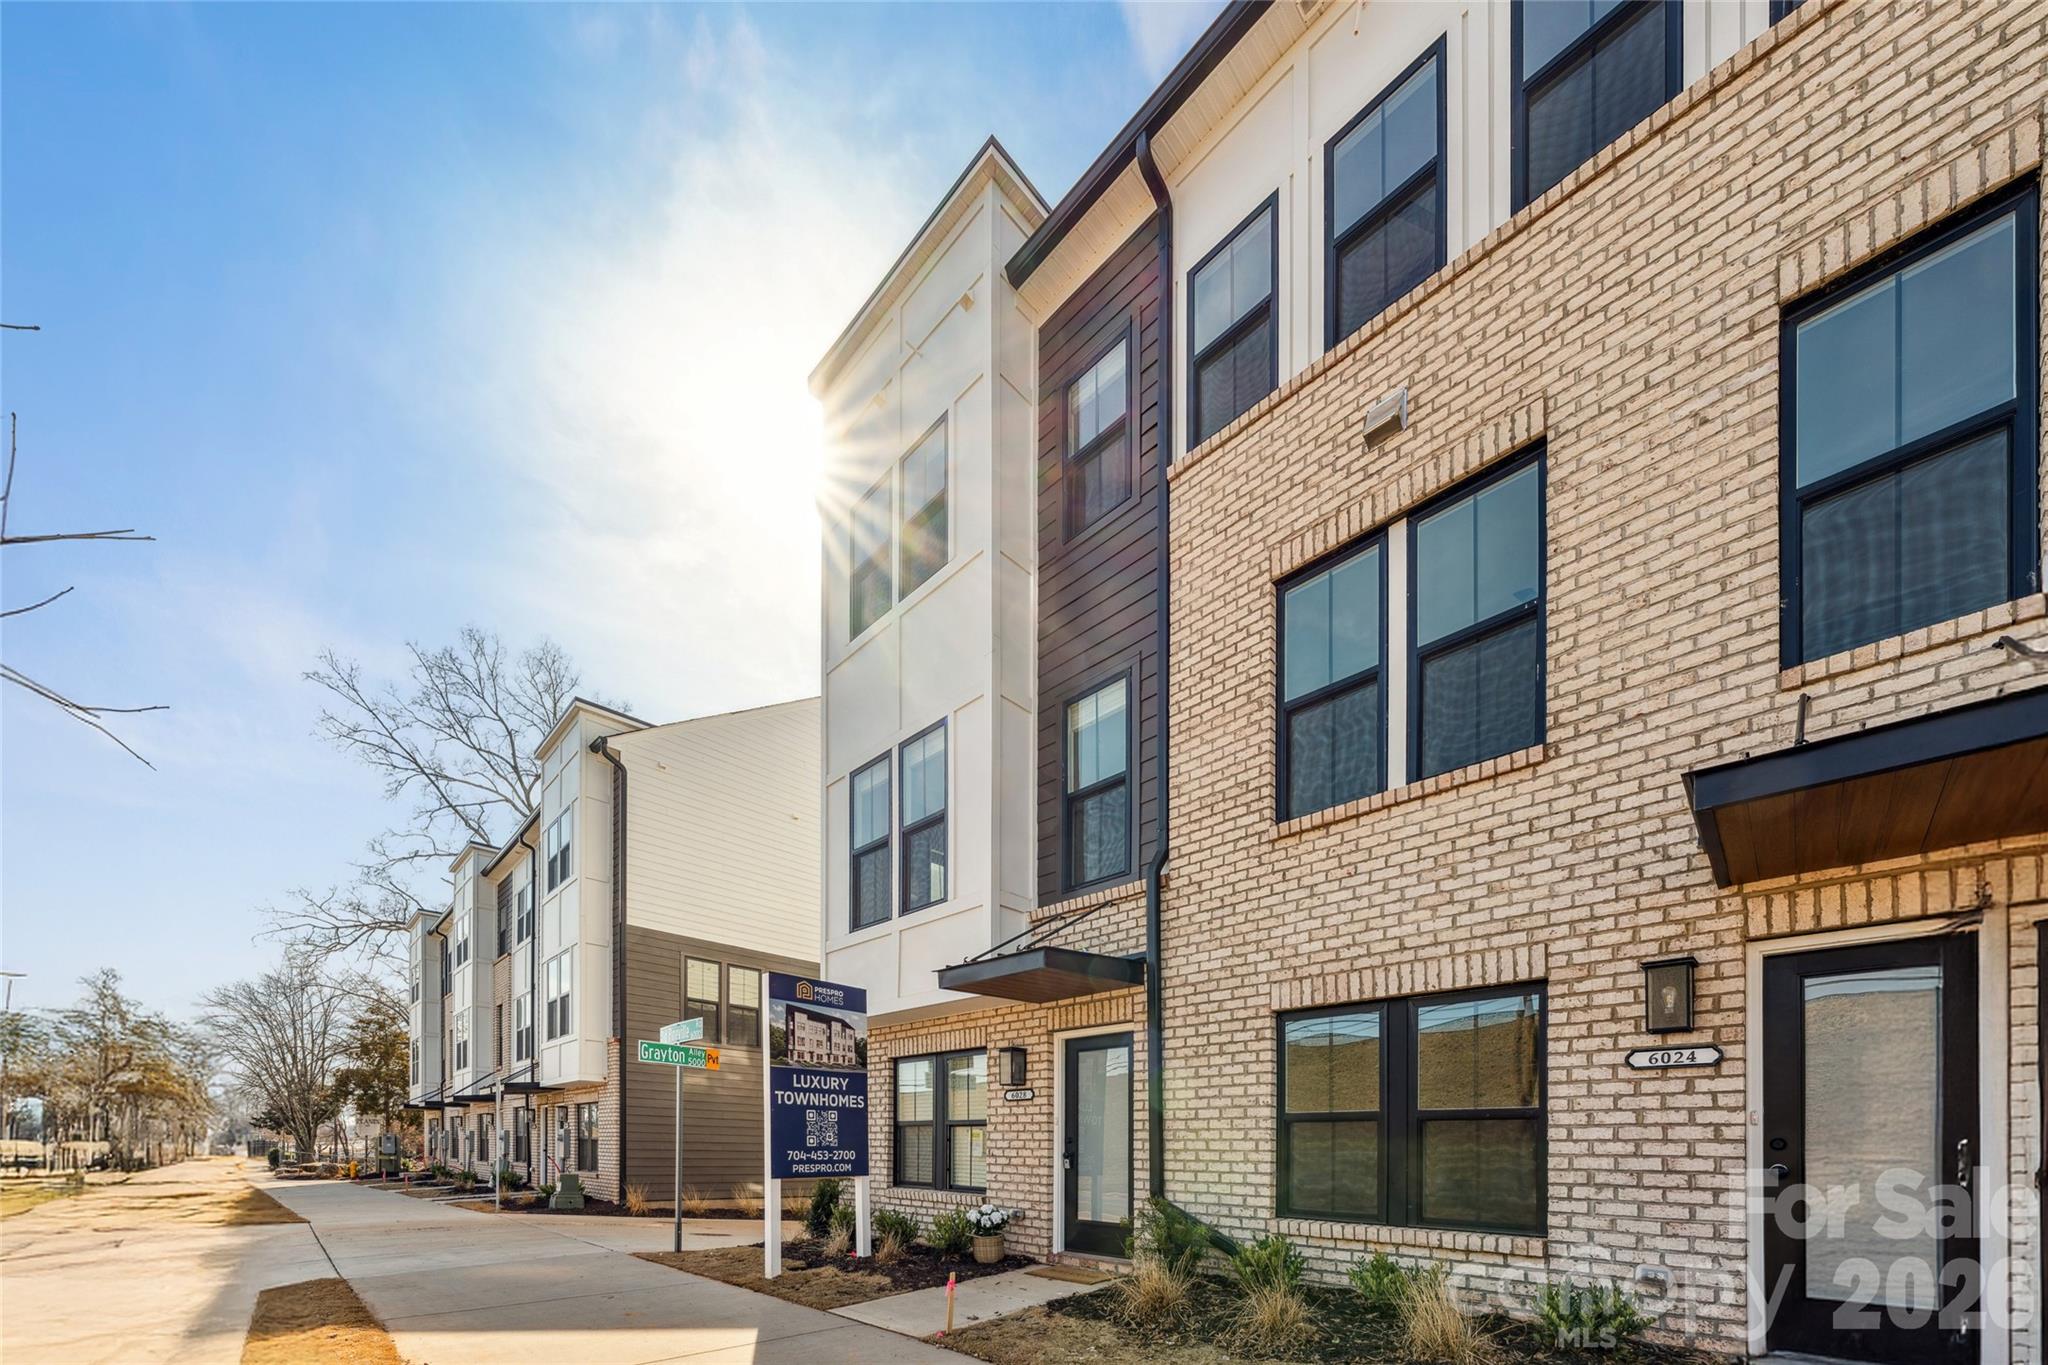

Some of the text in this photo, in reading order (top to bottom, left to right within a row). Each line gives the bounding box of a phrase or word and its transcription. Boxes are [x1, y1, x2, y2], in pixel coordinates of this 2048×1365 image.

[814, 986, 843, 997] PRESPRO
[814, 993, 844, 1006] HOMES
[641, 1043, 685, 1064] Grayton
[688, 1048, 719, 1065] Alley Pvt
[1648, 1050, 1697, 1065] 6024
[688, 1057, 705, 1067] 5000
[793, 1074, 849, 1091] LUXURY
[774, 1090, 865, 1108] TOWNHOMES
[787, 1150, 856, 1161] 704-453-2700
[792, 1163, 852, 1173] PRESPRO.COM
